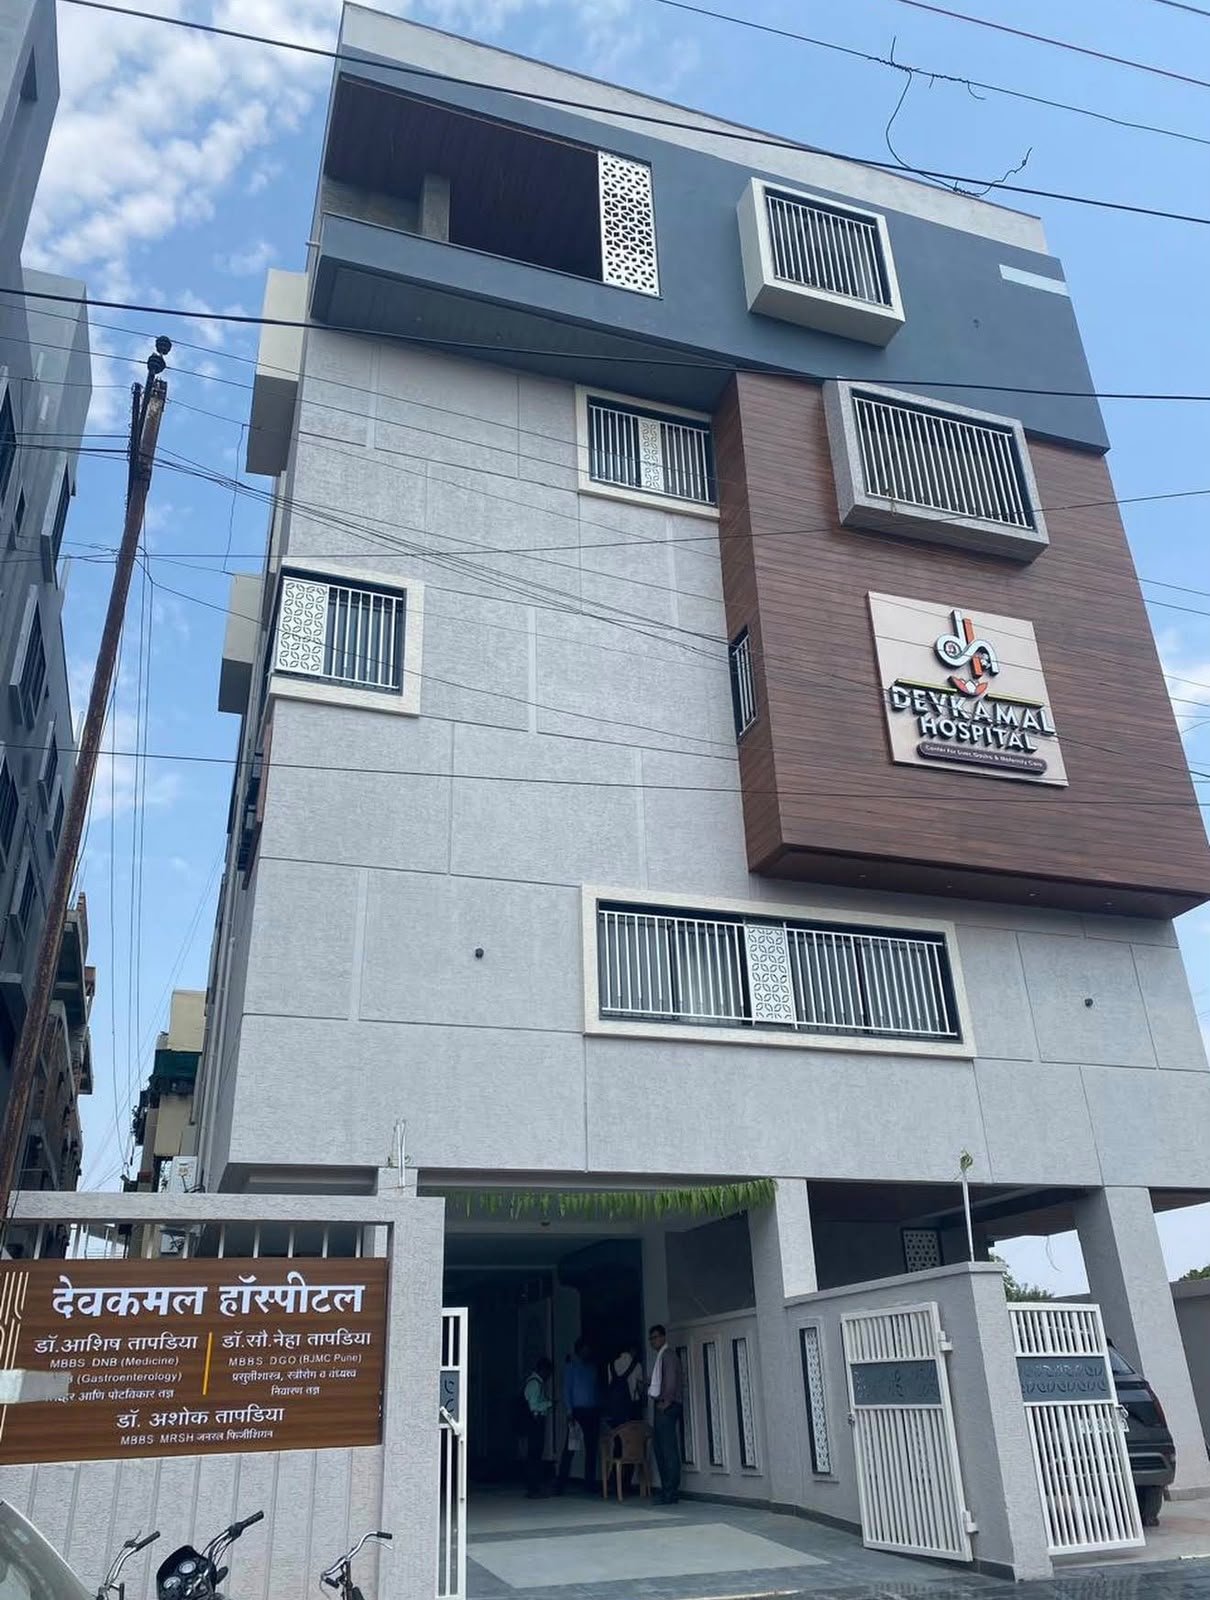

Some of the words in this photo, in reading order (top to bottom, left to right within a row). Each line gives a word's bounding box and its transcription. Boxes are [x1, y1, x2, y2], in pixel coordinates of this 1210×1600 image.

[890, 685, 1056, 736] DEVKAMAL
[917, 714, 1039, 753] HOSPITAL
[52, 1275, 208, 1319] देवकमल
[219, 1271, 366, 1317] हॉस्पीटल
[127, 1331, 199, 1351] तापडिया
[307, 1328, 372, 1346] तापडिया
[49, 1359, 86, 1369] MBBS
[92, 1358, 117, 1367] DNB
[120, 1355, 179, 1367] (Medicine)
[228, 1356, 264, 1367] MBBS
[269, 1355, 296, 1365] DGO
[299, 1354, 331, 1365] (BJMC
[333, 1353, 362, 1363] Pune)
[77, 1371, 183, 1385] (Gastroenterology)
[116, 1408, 141, 1428] डॉ.
[149, 1406, 210, 1427] अशोक
[215, 1403, 286, 1424] तापडिया
[120, 1434, 154, 1446] MBBS
[159, 1432, 195, 1443] MRSH
